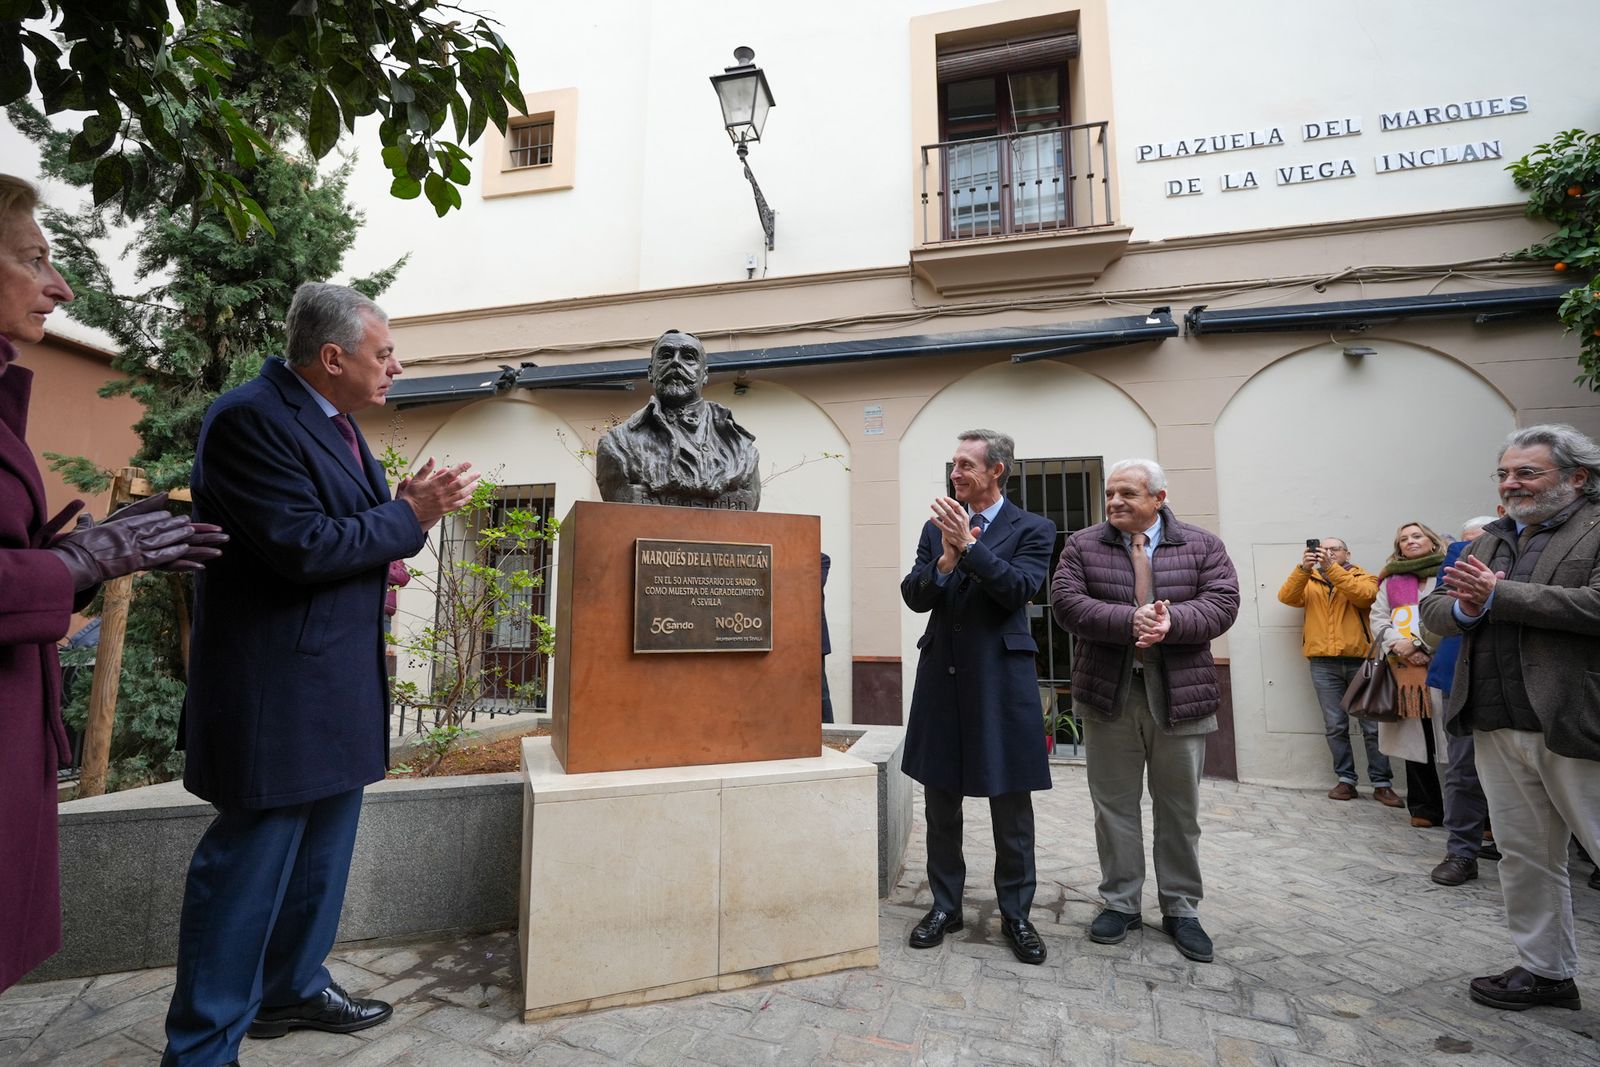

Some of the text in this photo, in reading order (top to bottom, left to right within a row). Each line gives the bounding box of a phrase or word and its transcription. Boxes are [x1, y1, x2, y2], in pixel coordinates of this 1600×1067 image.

[1139, 95, 1528, 160] PLAZUELA DEL MARQUES
[1167, 140, 1500, 195] DE LA VEGA INCLAN
[641, 547, 769, 569] MARQUÉS DE LA VEGA INCLÁN
[653, 576, 757, 587] EN EL 50 ANIVERSARIO DE SANDO
[645, 586, 765, 597] COMO MUESTRA DE AGRADECIMIENTO
[690, 597, 722, 606] A SEVILLA
[666, 621, 694, 630] sando
